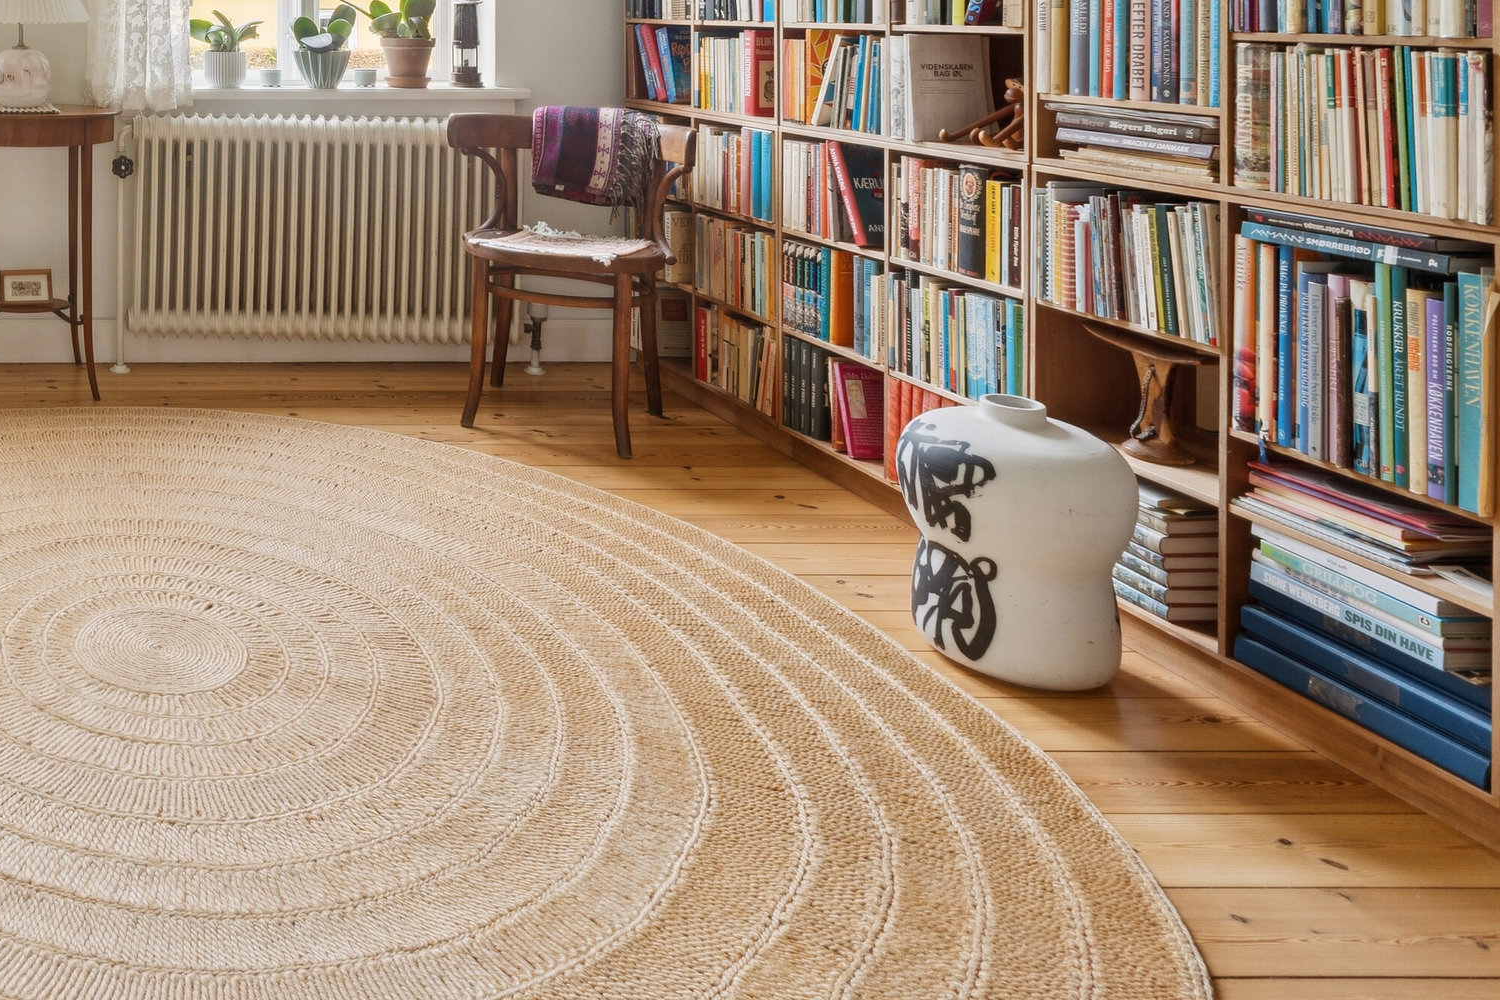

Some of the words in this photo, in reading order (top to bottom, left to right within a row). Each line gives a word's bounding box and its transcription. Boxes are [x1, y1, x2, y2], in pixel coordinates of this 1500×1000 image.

[1132, 2, 1145, 39] EFTER
[1201, 30, 1210, 57] ideers
[920, 63, 974, 71] VIDENSKABEN
[1132, 44, 1145, 91] DRABET
[1200, 60, 1210, 94] historie
[1236, 64, 1252, 87] Ma
[1081, 118, 1105, 128] Meyer
[1108, 120, 1143, 132] Meyers
[1144, 124, 1177, 136] Bageri
[1236, 93, 1252, 157] CUISINE
[830, 148, 841, 166] ANNA
[1122, 138, 1148, 148] SMAGEN
[1156, 142, 1190, 153] DANMARK
[834, 167, 845, 191] EKBERG
[1305, 237, 1371, 255] SMØRREBRØD
[1236, 245, 1246, 291] Asiatiske
[1280, 260, 1288, 281] SMAG
[1280, 283, 1291, 293] PÅ
[1280, 295, 1288, 336] PROVENCE
[1301, 292, 1309, 342] POLITIKENS
[1393, 300, 1403, 353] KRUKKER
[1394, 358, 1405, 388] ÅRET
[1432, 369, 1438, 379] OM
[1395, 390, 1405, 431] RUNDT
[1429, 382, 1443, 461] KØKKENHAVEN
[1302, 562, 1378, 604] GRILLBOG
[1263, 571, 1287, 588] SIGNE
[1289, 583, 1340, 616] WENNEBERG
[1344, 610, 1372, 632] SPIS
[1375, 623, 1396, 643] DIN
[1399, 636, 1434, 662] HAVE
